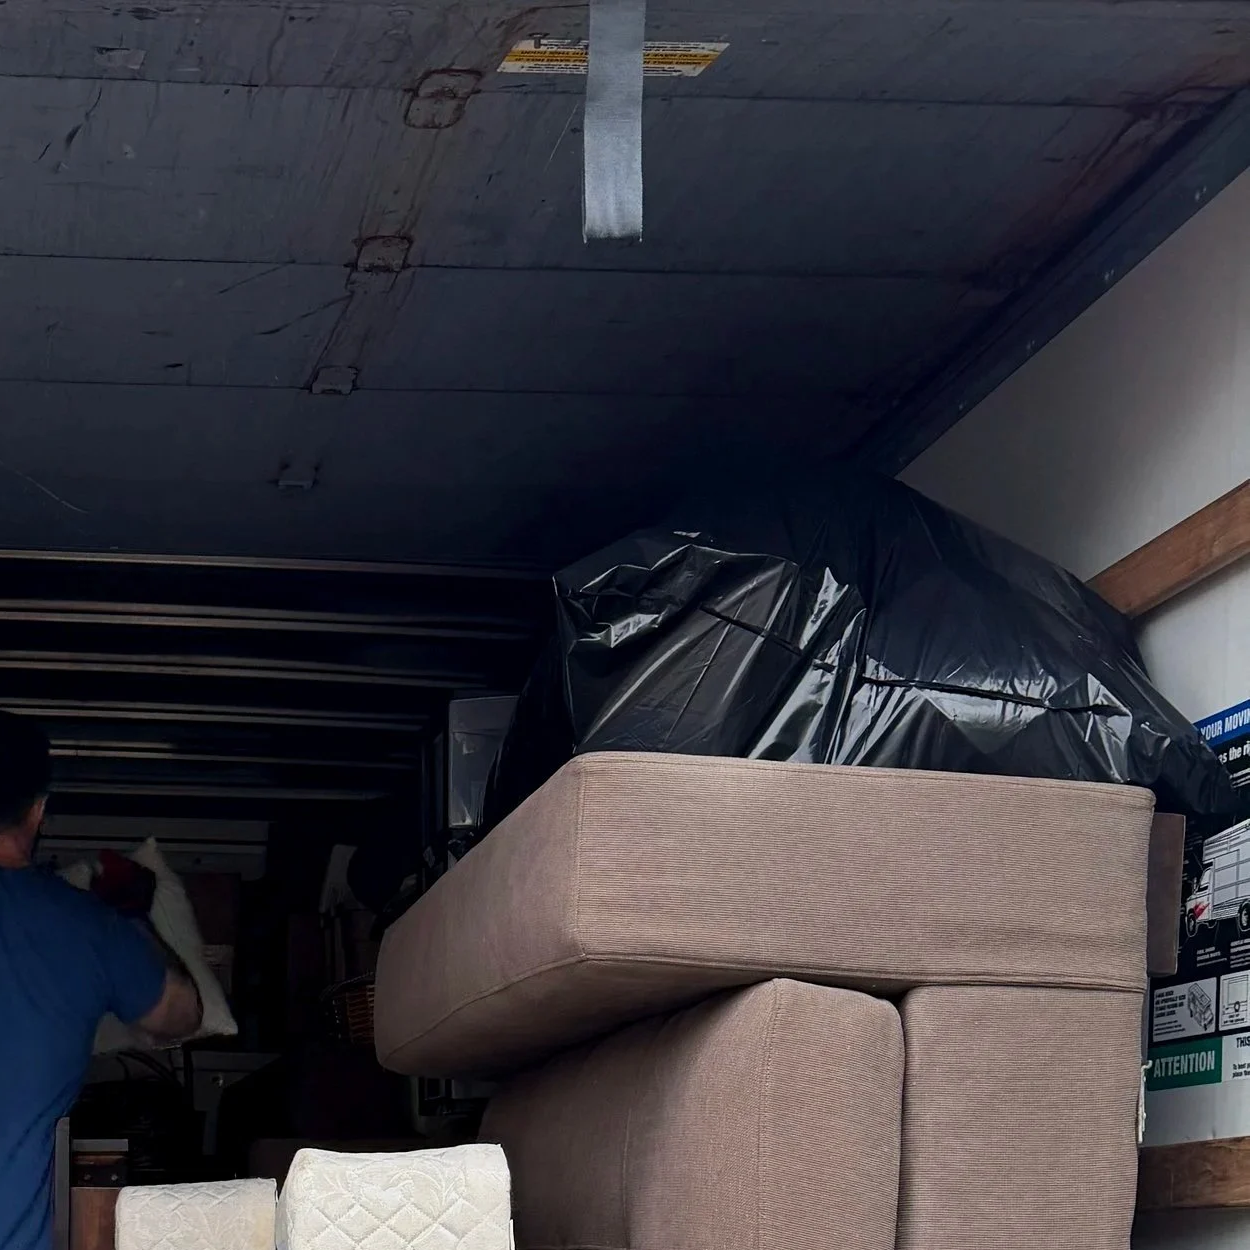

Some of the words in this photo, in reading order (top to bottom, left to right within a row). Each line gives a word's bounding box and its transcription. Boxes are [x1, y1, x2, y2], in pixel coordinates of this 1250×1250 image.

[1200, 720, 1223, 741] YOUR
[1229, 746, 1242, 761] the
[1153, 1050, 1215, 1078] ATTENTION
